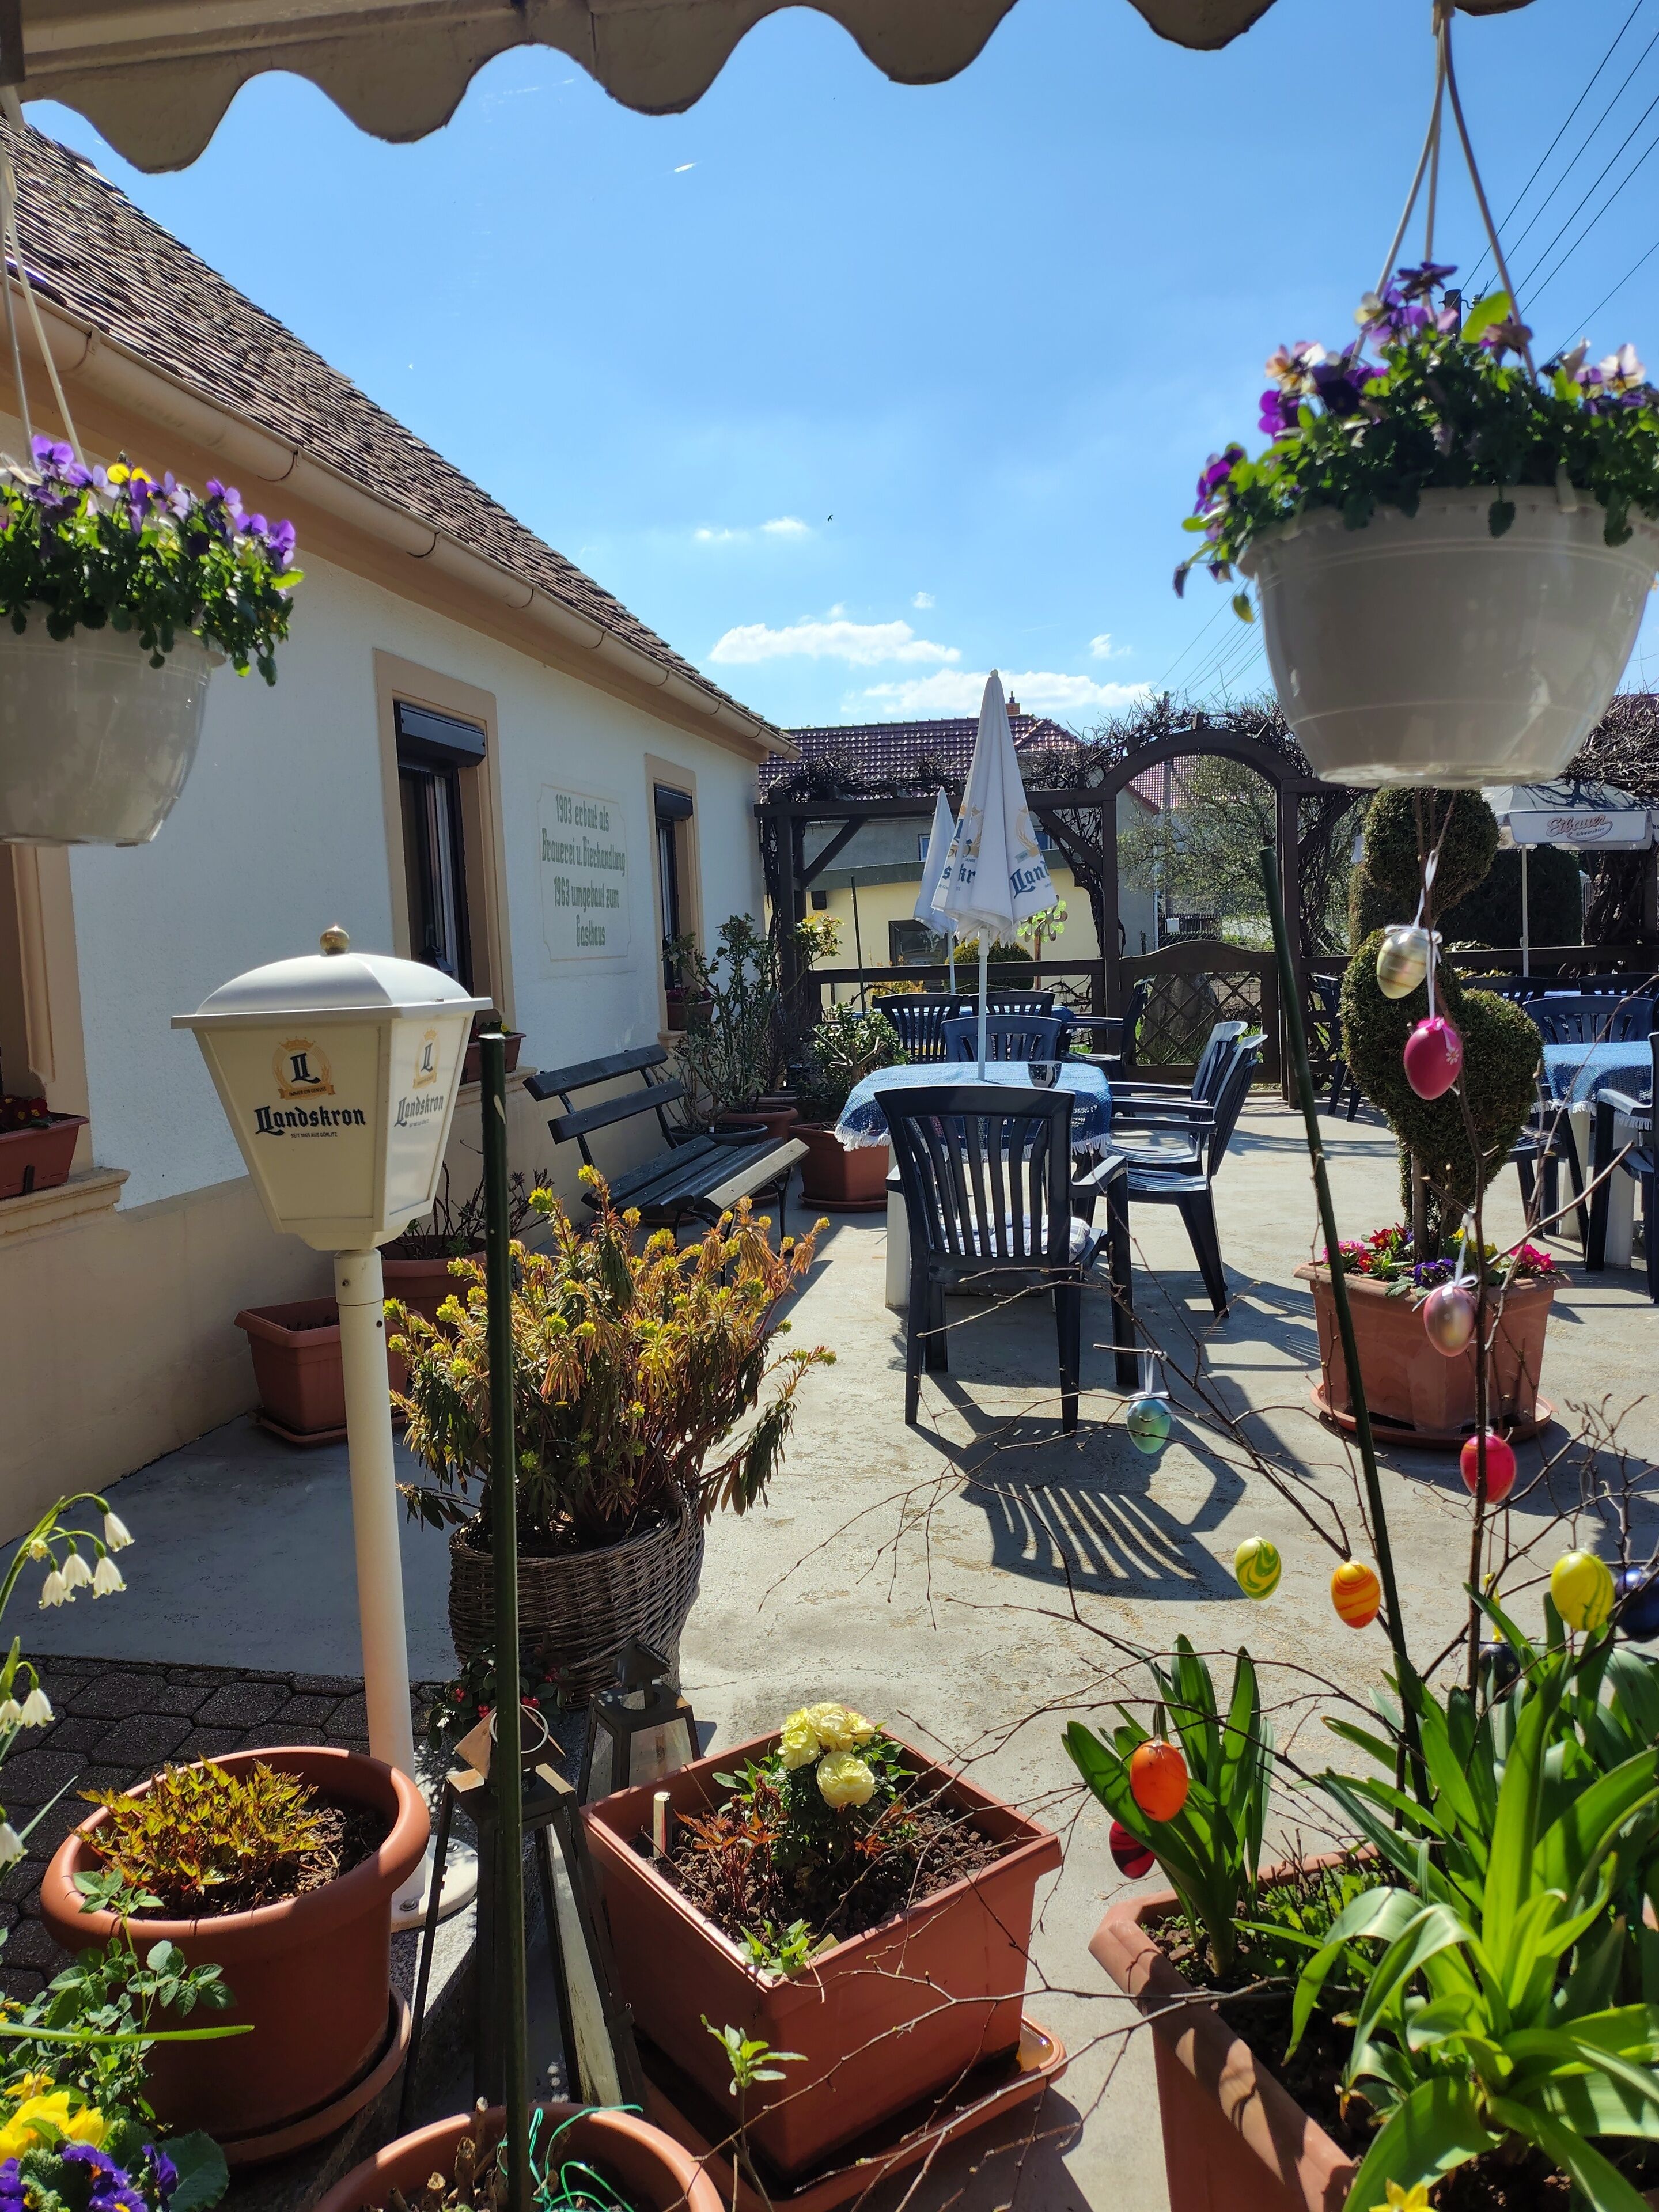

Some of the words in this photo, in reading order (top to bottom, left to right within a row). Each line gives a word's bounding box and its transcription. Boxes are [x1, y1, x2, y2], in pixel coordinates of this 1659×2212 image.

[555, 794, 572, 824] 1903
[575, 800, 597, 830] erbaut
[599, 806, 609, 832] als
[1546, 814, 1606, 837] Eibauer
[542, 828, 575, 865] Brauerei
[554, 876, 570, 907] 1963
[571, 880, 605, 913] umgebaut
[606, 888, 619, 908] zum
[576, 914, 605, 947] Gasthaus
[254, 1105, 366, 1136] Landskron
[394, 1094, 444, 1128] Landskron
